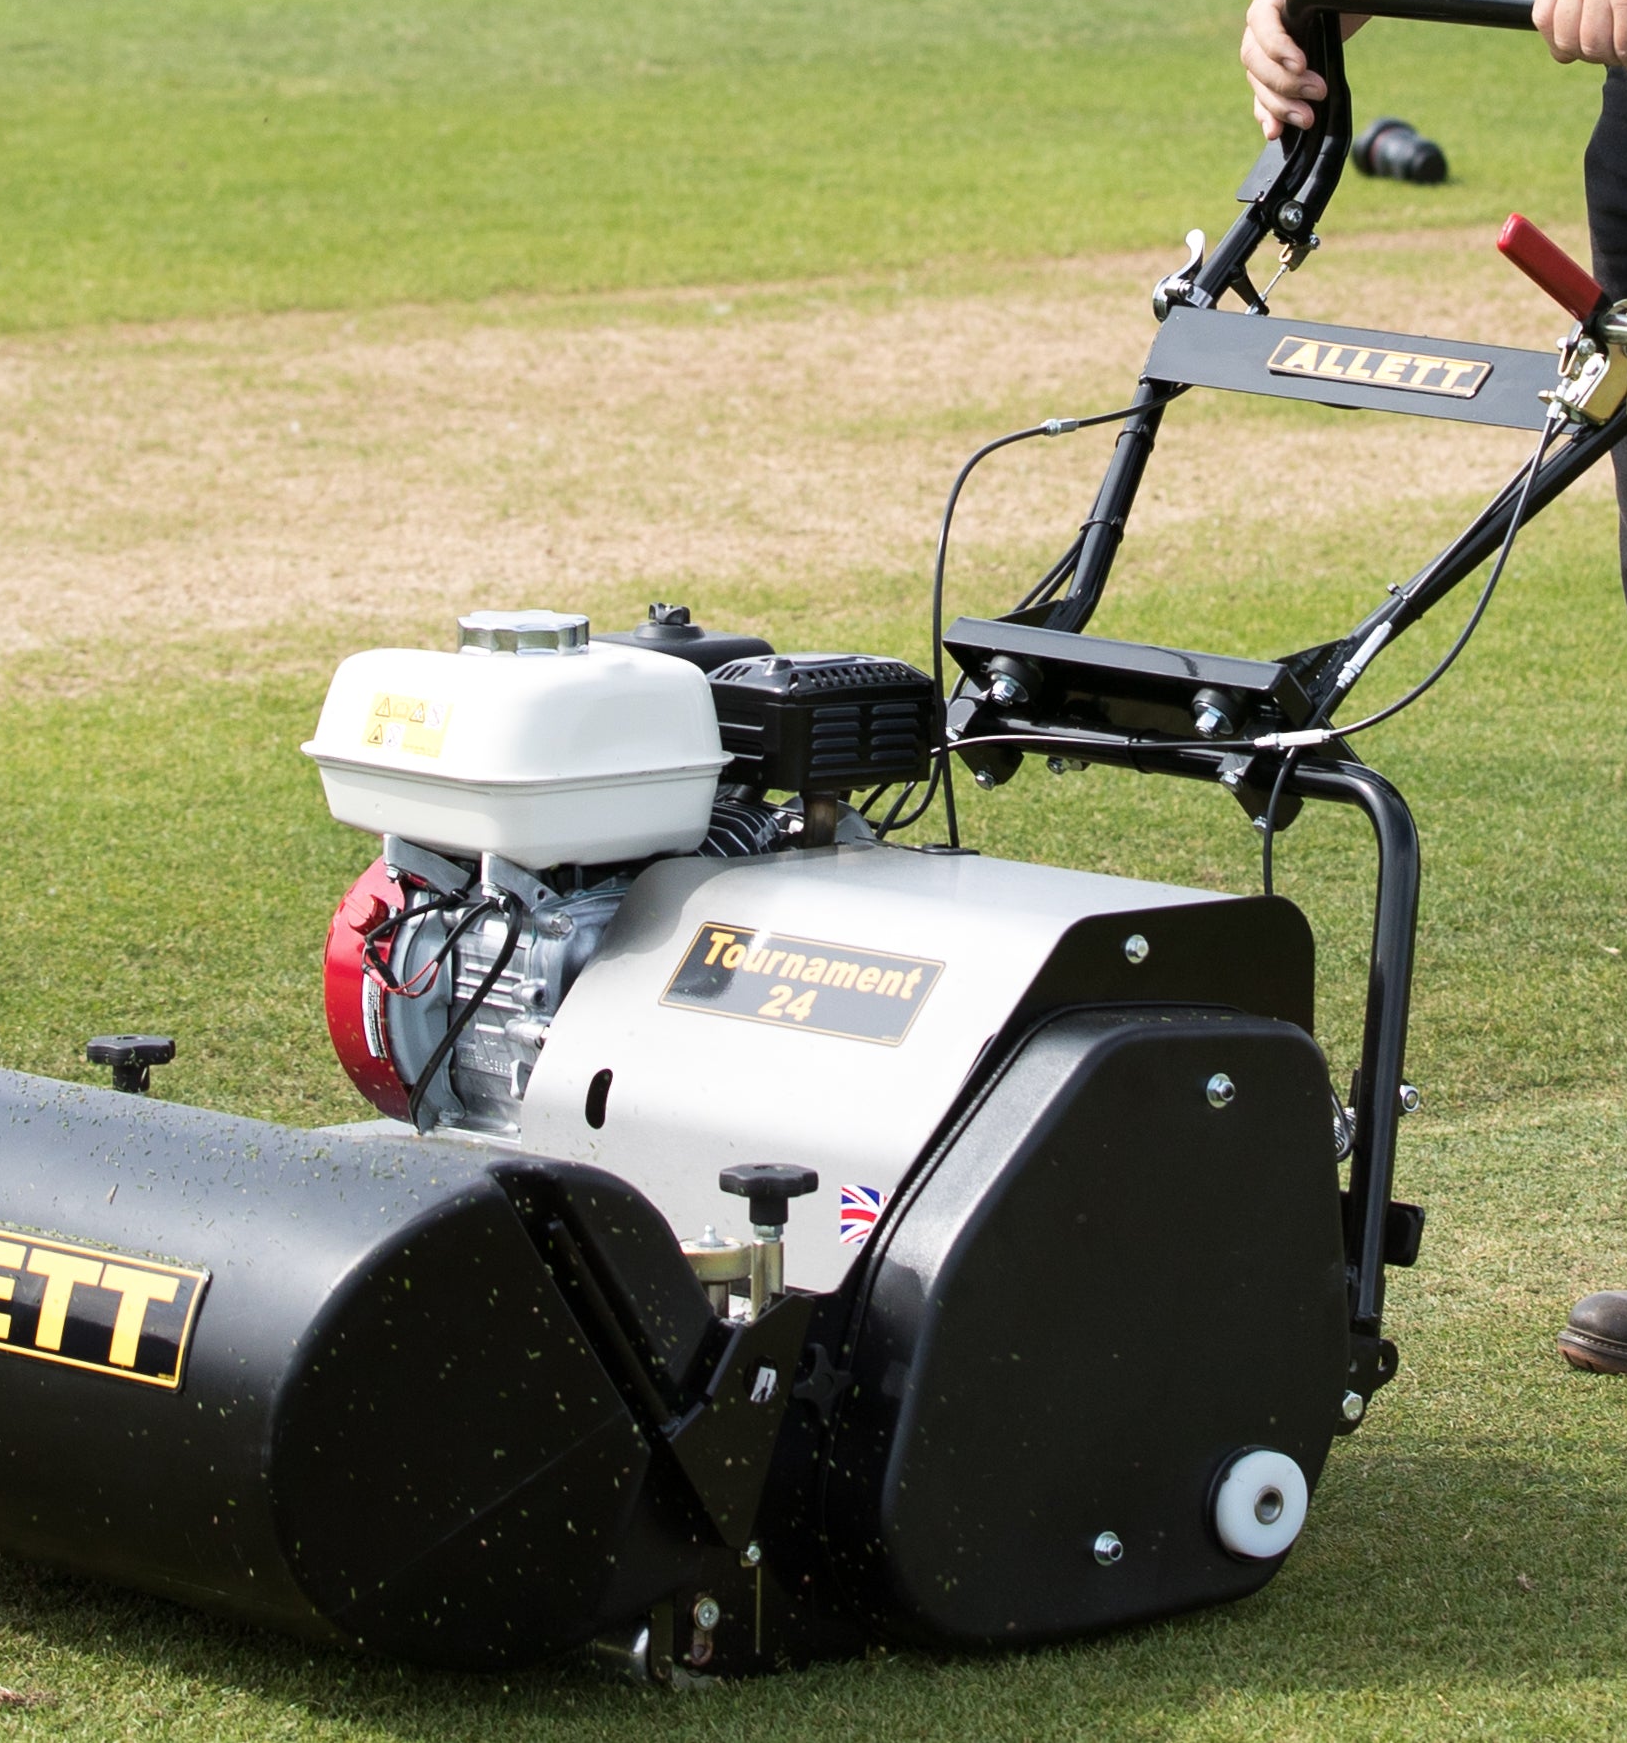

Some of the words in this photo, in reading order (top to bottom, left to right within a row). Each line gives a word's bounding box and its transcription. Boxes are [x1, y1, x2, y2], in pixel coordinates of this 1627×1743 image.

[1284, 343, 1473, 388] ALLETT
[704, 931, 923, 1000] Tournament
[758, 984, 818, 1022] 24
